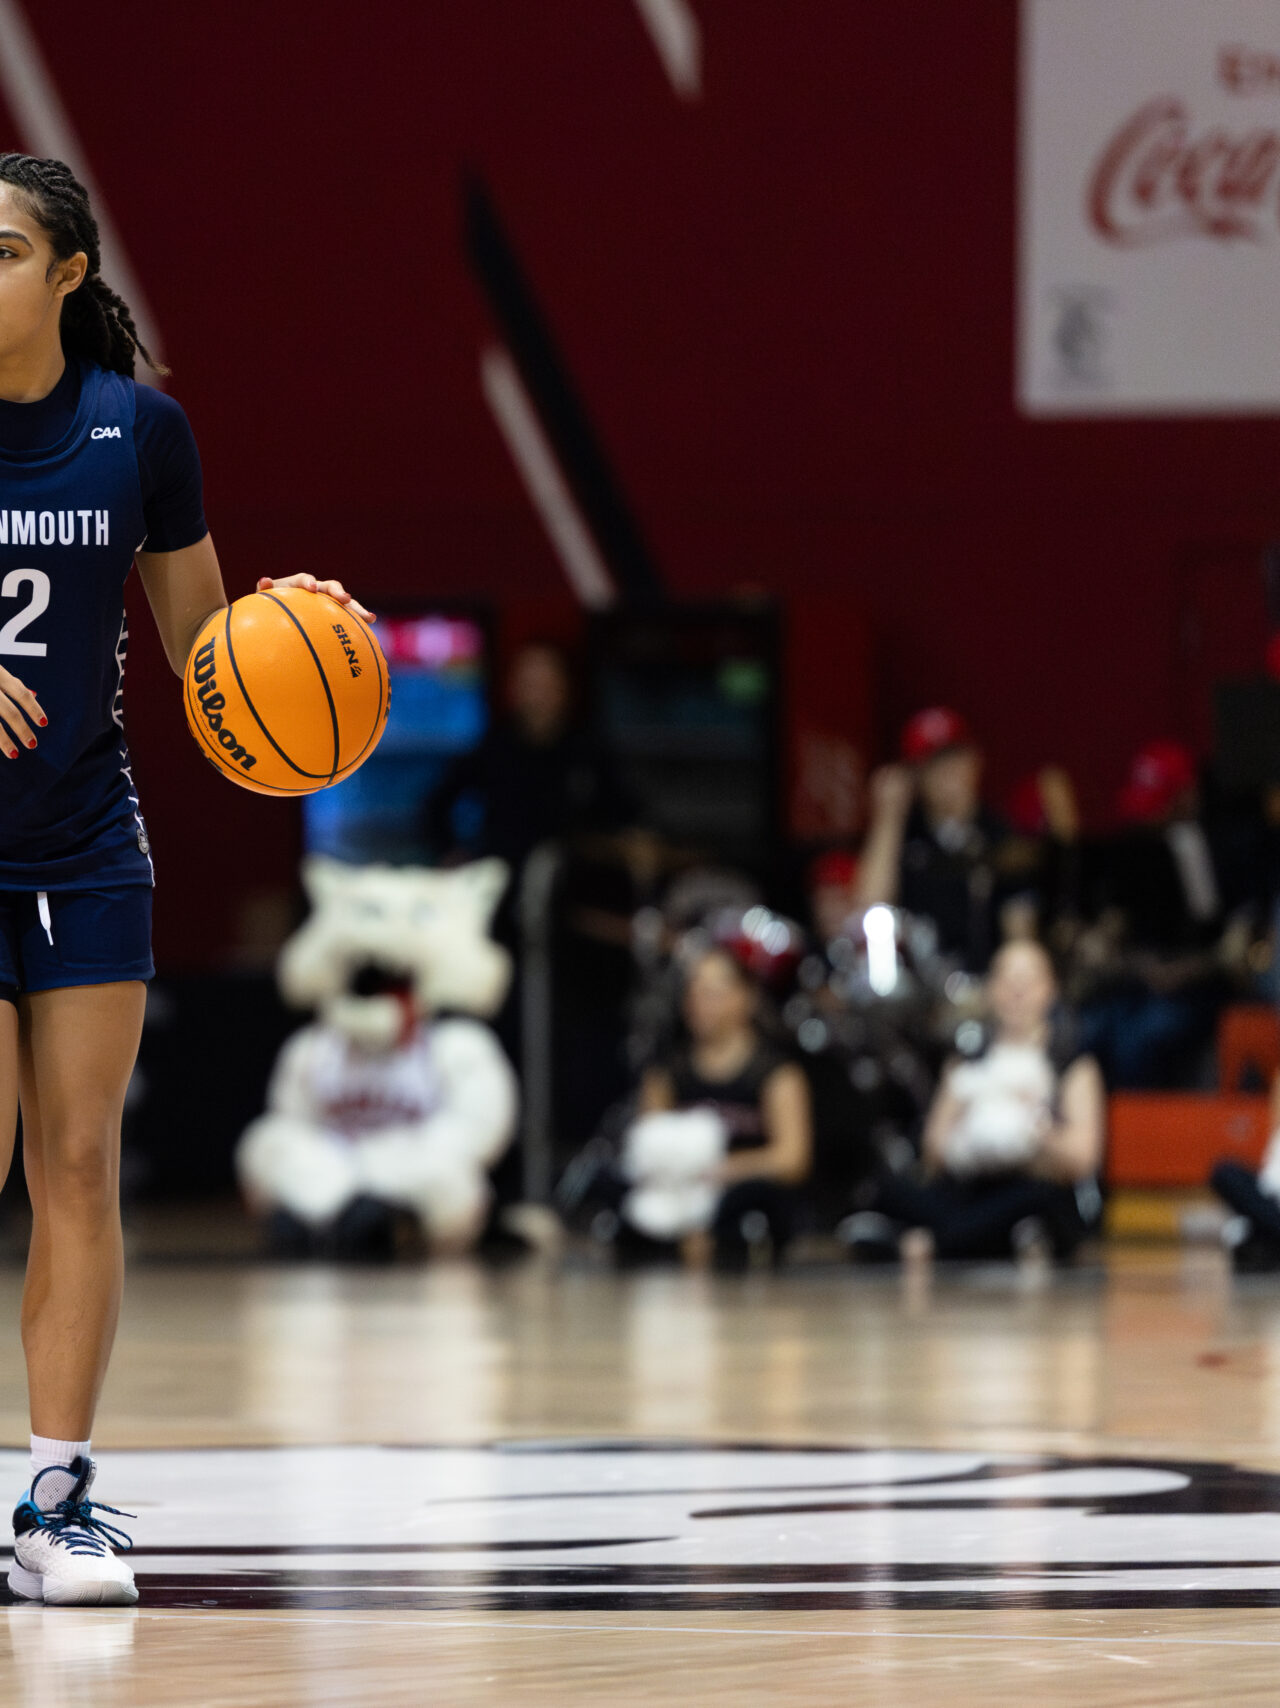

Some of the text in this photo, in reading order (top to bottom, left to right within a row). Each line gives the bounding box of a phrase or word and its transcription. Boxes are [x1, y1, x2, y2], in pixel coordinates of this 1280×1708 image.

[90, 426, 122, 440] CAA
[332, 624, 359, 665] NFHS
[194, 636, 257, 771] Wilson
